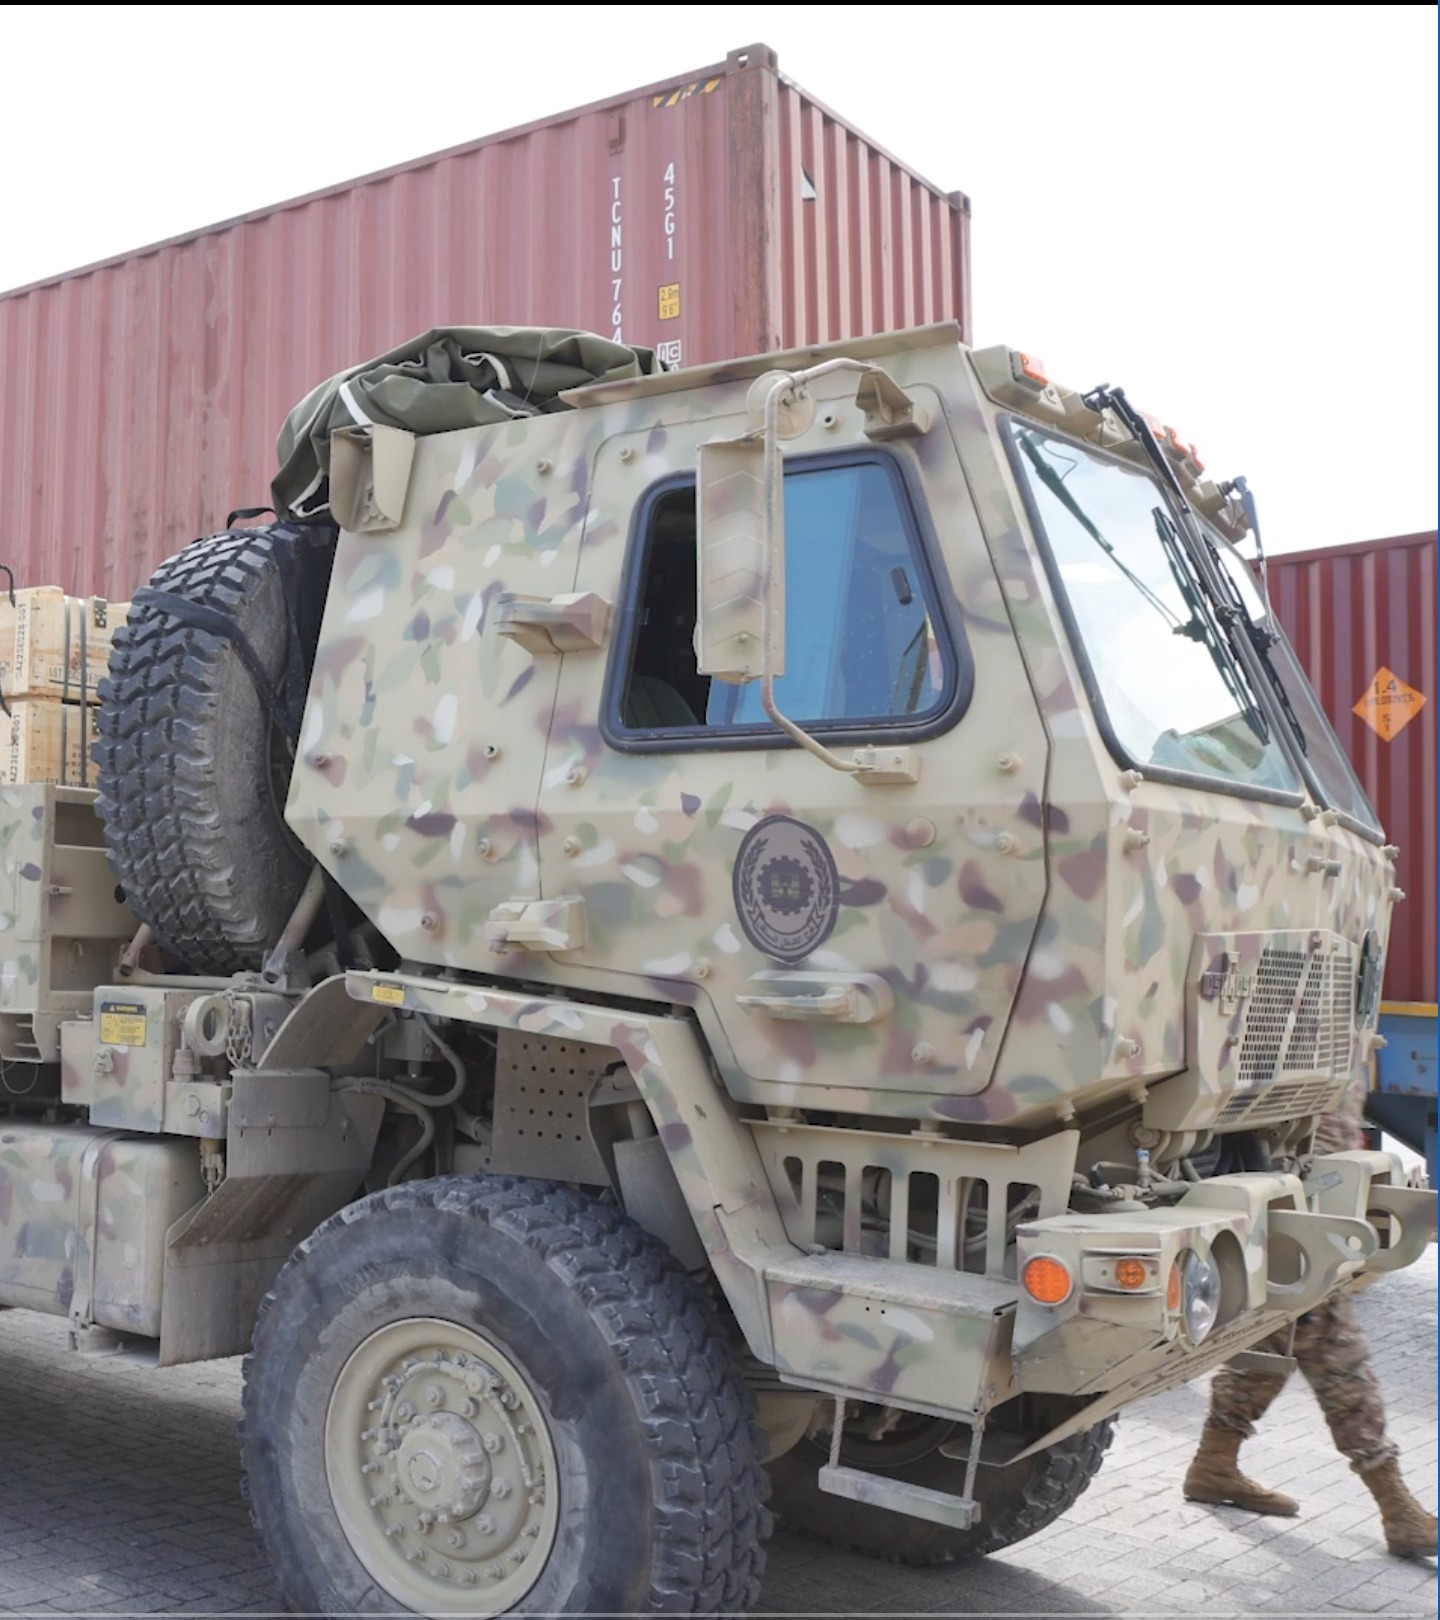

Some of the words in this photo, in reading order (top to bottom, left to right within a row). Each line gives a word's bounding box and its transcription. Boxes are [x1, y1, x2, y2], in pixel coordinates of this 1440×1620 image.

[611, 176, 622, 272] TCNU
[663, 162, 675, 260] 45G1
[611, 278, 623, 345] 764
[49, 666, 63, 678] LOT
[1375, 679, 1397, 694] 1.4
